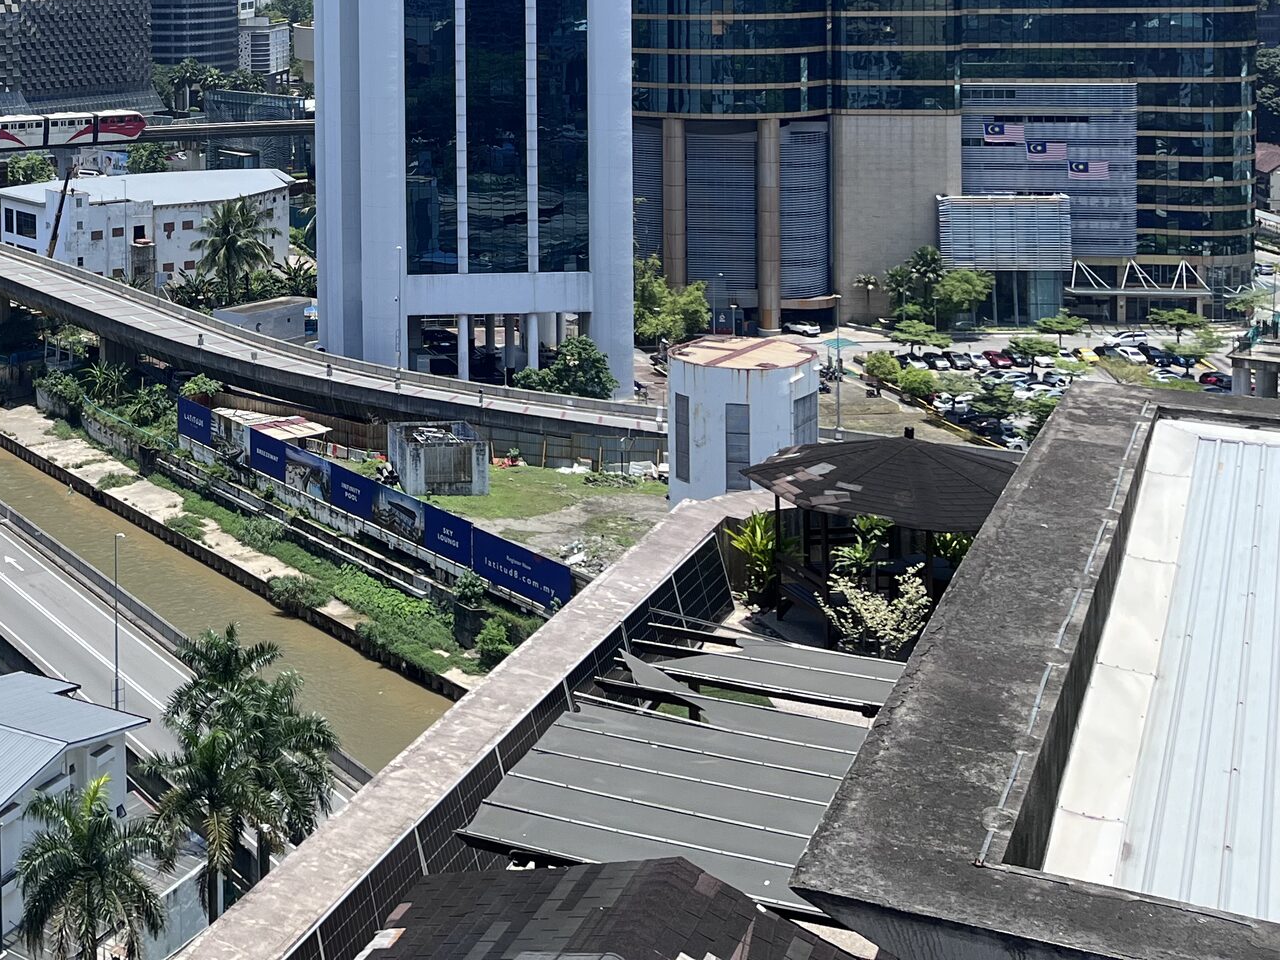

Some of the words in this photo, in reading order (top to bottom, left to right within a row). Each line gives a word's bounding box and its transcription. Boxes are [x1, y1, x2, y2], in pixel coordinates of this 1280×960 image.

[344, 491, 358, 502] POOL
[437, 533, 459, 548] LOUNGE
[484, 556, 556, 597] latitud8.com.my
